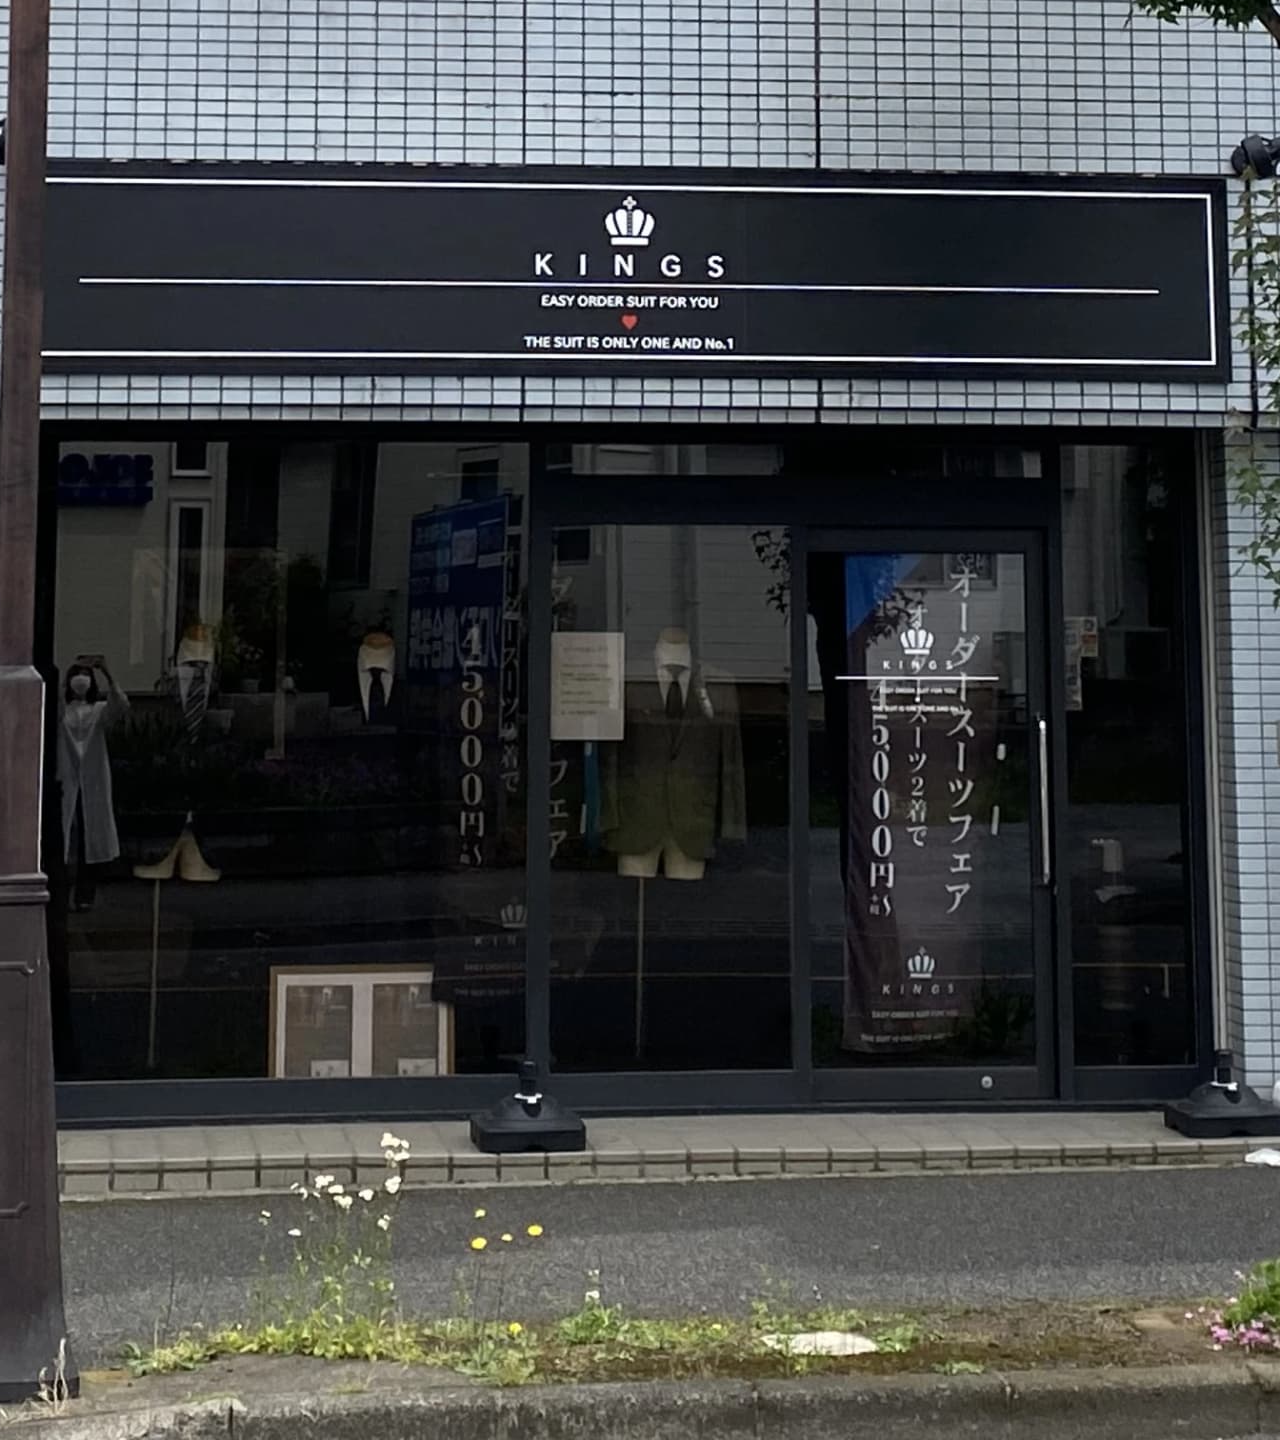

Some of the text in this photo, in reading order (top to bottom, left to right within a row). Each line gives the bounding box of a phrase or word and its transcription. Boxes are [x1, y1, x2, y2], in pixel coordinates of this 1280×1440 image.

[535, 252, 725, 279] KINGS
[540, 294, 719, 309] EASY ORDER SUIT FOR YOU
[523, 335, 735, 350] THE SUIT IS ONLY ONE AND No.1
[946, 565, 980, 914] オーダースーツフェア
